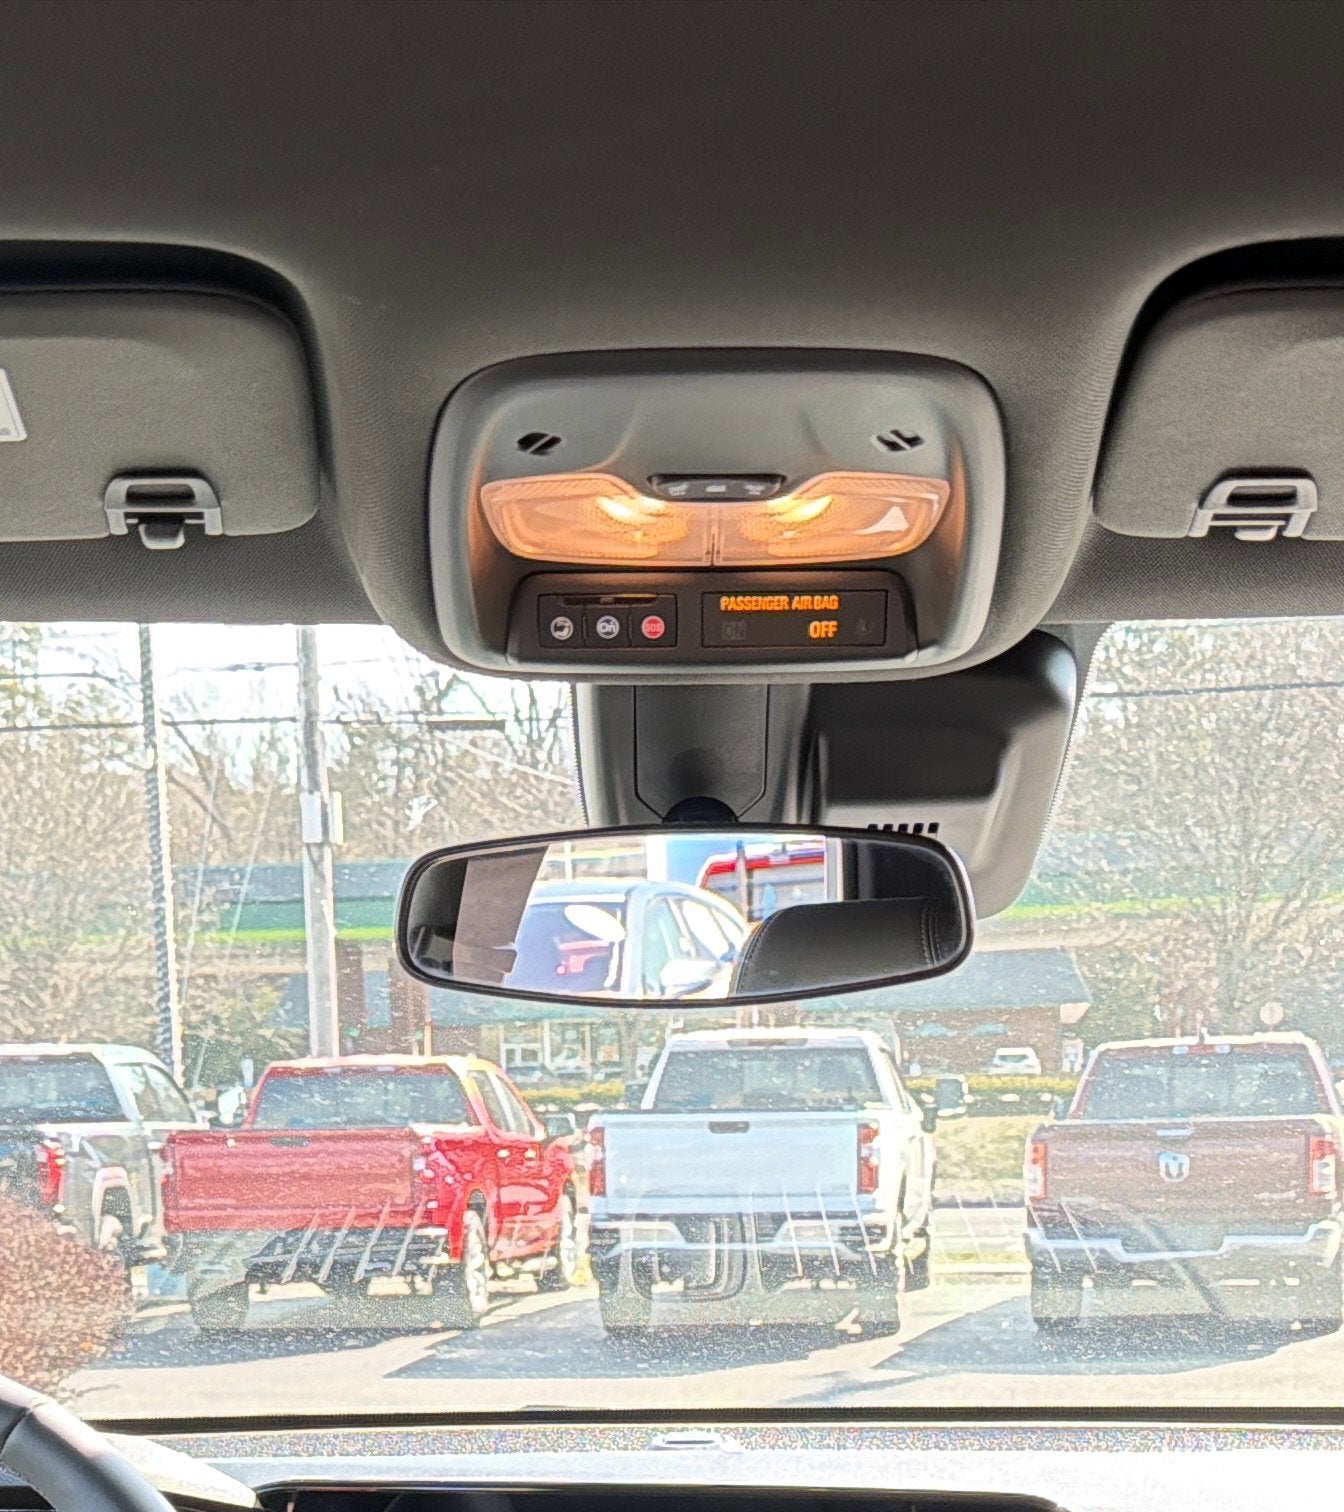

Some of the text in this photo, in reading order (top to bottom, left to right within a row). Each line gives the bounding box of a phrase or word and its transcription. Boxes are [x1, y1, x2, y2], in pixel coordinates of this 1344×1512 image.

[720, 594, 839, 612] PASSENGER AIR BAG
[809, 620, 838, 639] OFF
